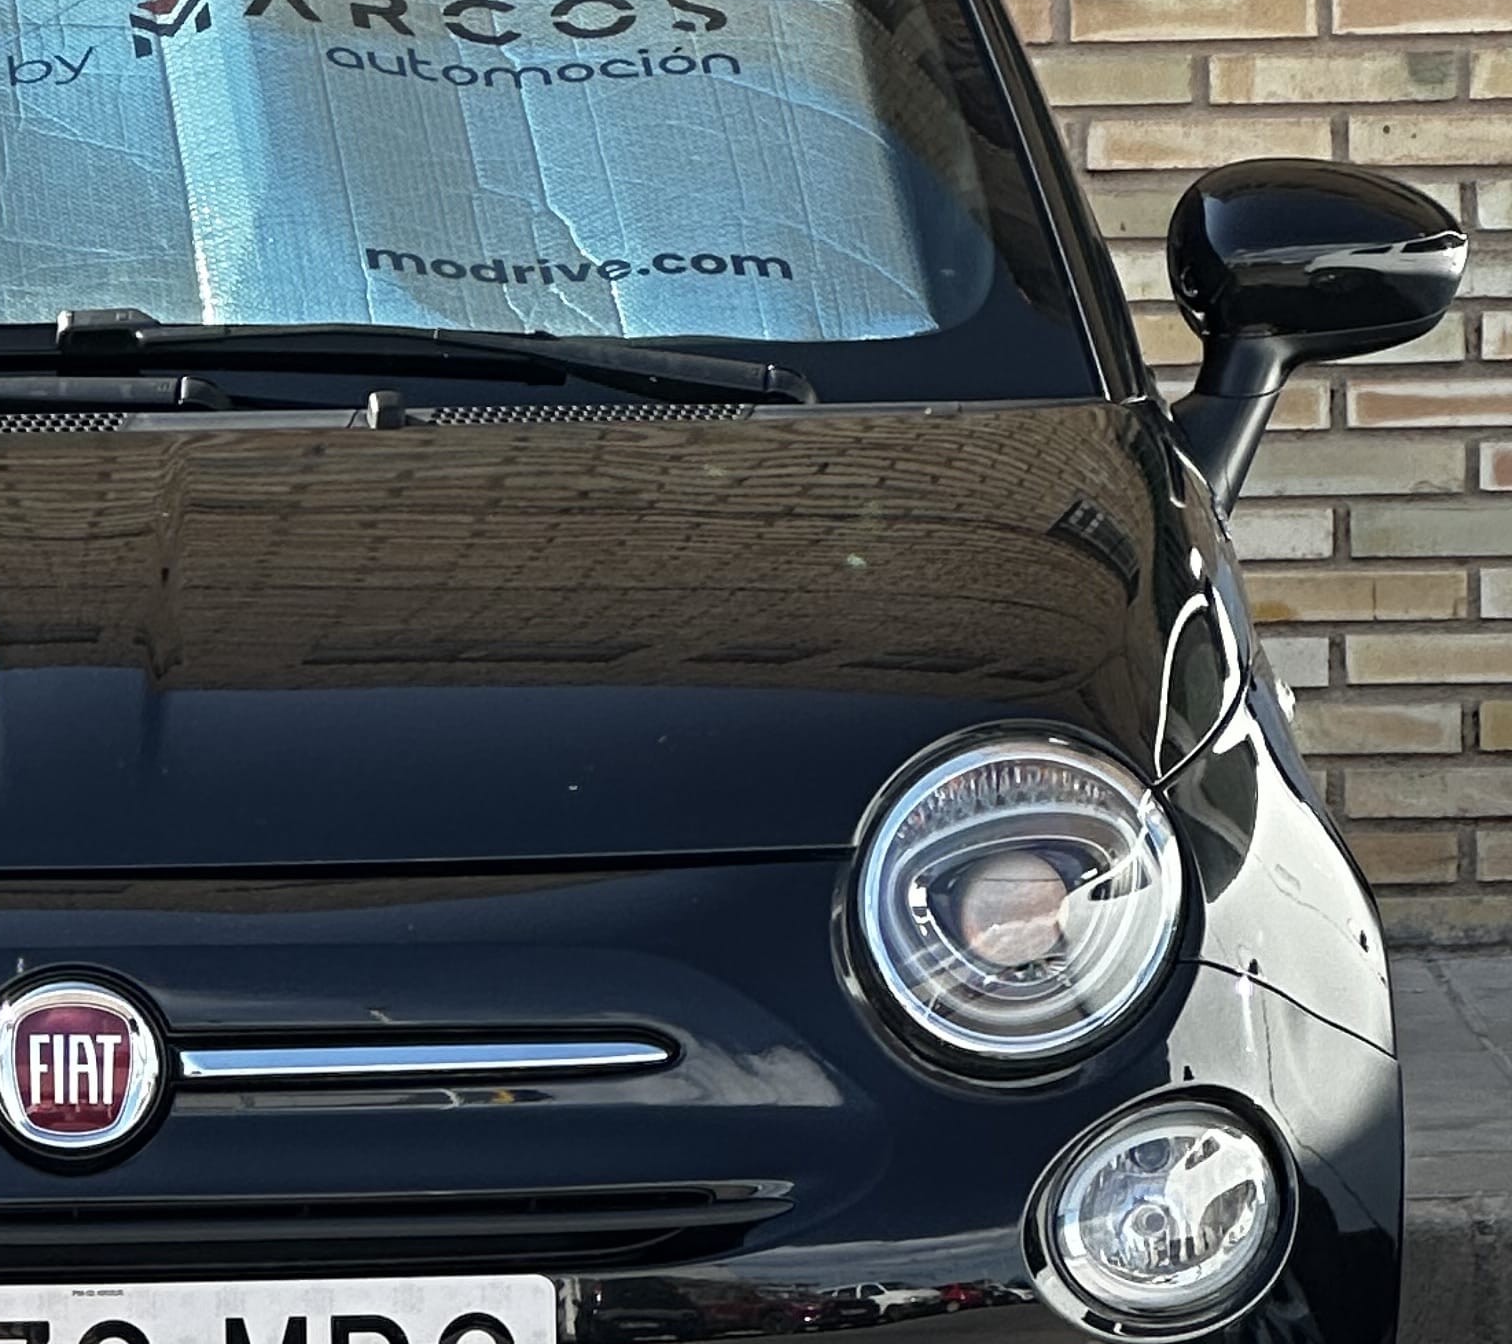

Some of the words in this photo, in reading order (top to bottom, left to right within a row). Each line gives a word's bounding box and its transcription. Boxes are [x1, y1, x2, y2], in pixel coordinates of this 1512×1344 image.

[8, 45, 95, 87] by
[326, 44, 742, 90] automoción
[366, 246, 795, 287] modrive.com
[28, 1033, 122, 1105] FIAT
